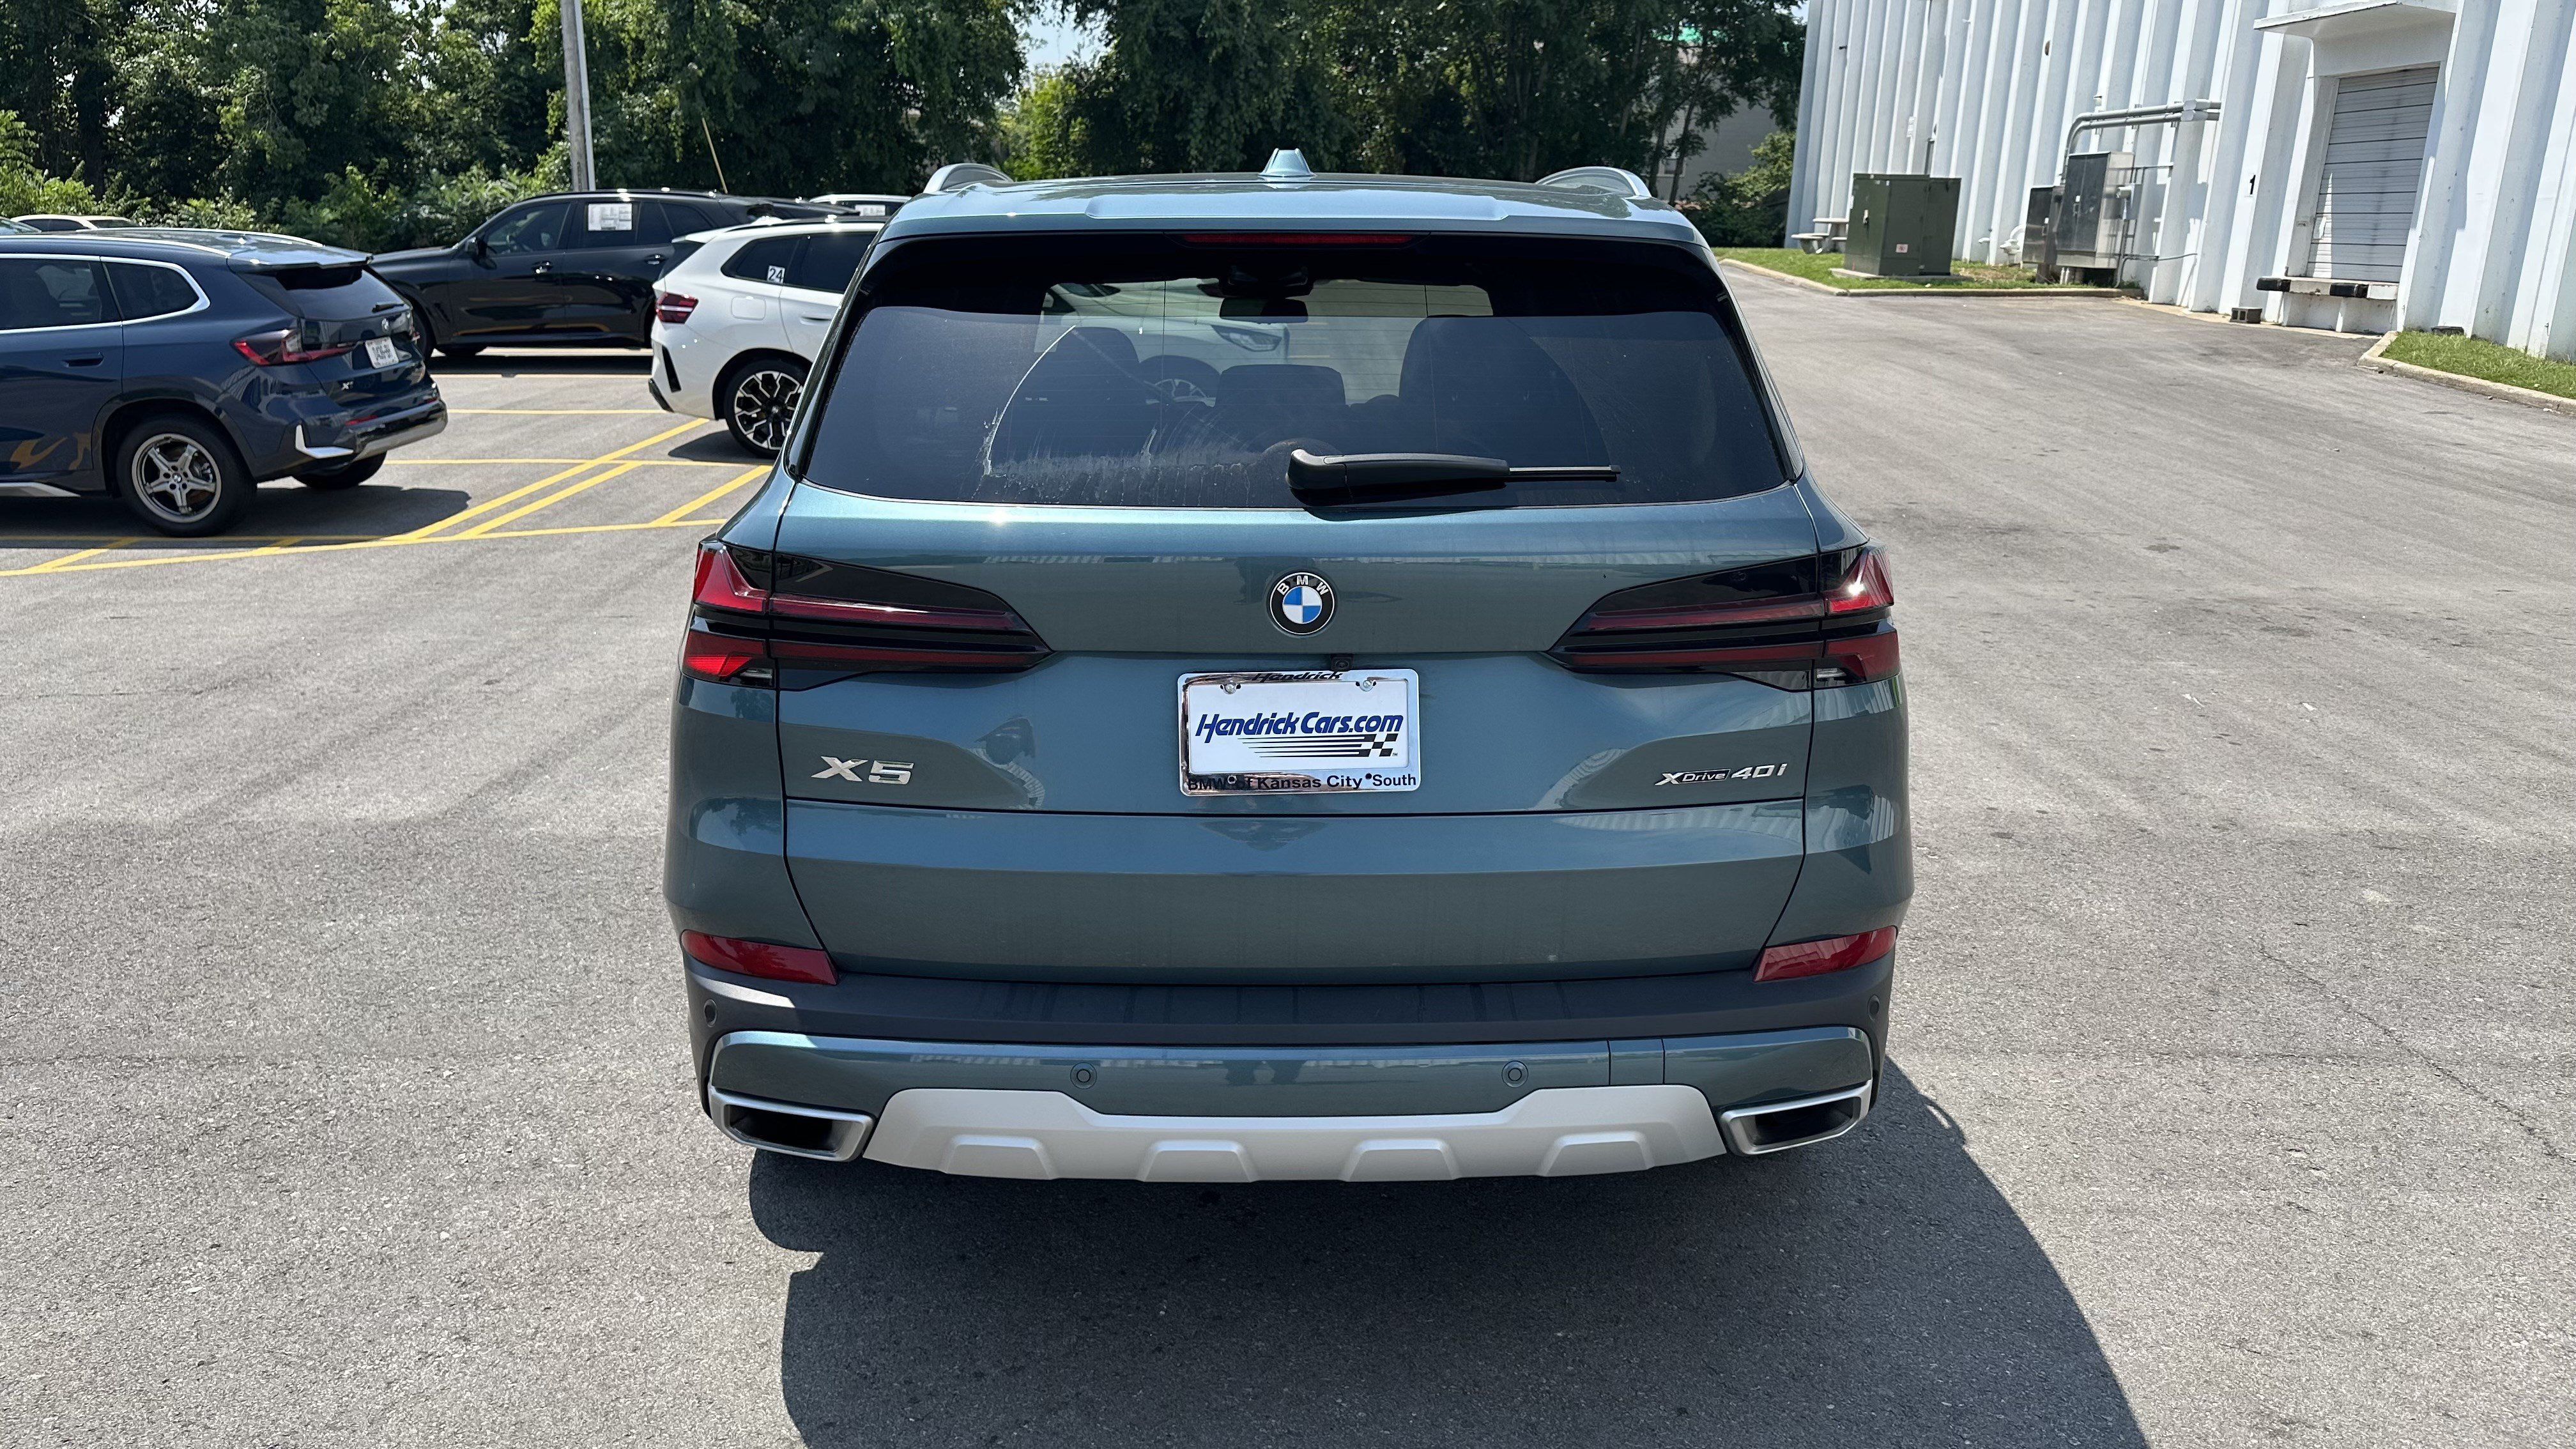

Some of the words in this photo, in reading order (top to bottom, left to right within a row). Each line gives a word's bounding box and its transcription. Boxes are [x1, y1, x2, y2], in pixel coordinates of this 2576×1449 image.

[768, 268, 784, 282] 24
[1277, 575, 1329, 595] BMW
[1252, 671, 1343, 683] Hendrick
[811, 756, 914, 785] X5
[1731, 763, 1788, 779] 40i
[1188, 778, 1227, 790] BMW
[1257, 777, 1322, 790] Kansas
[1326, 775, 1363, 790] City
[1372, 774, 1416, 786] South
